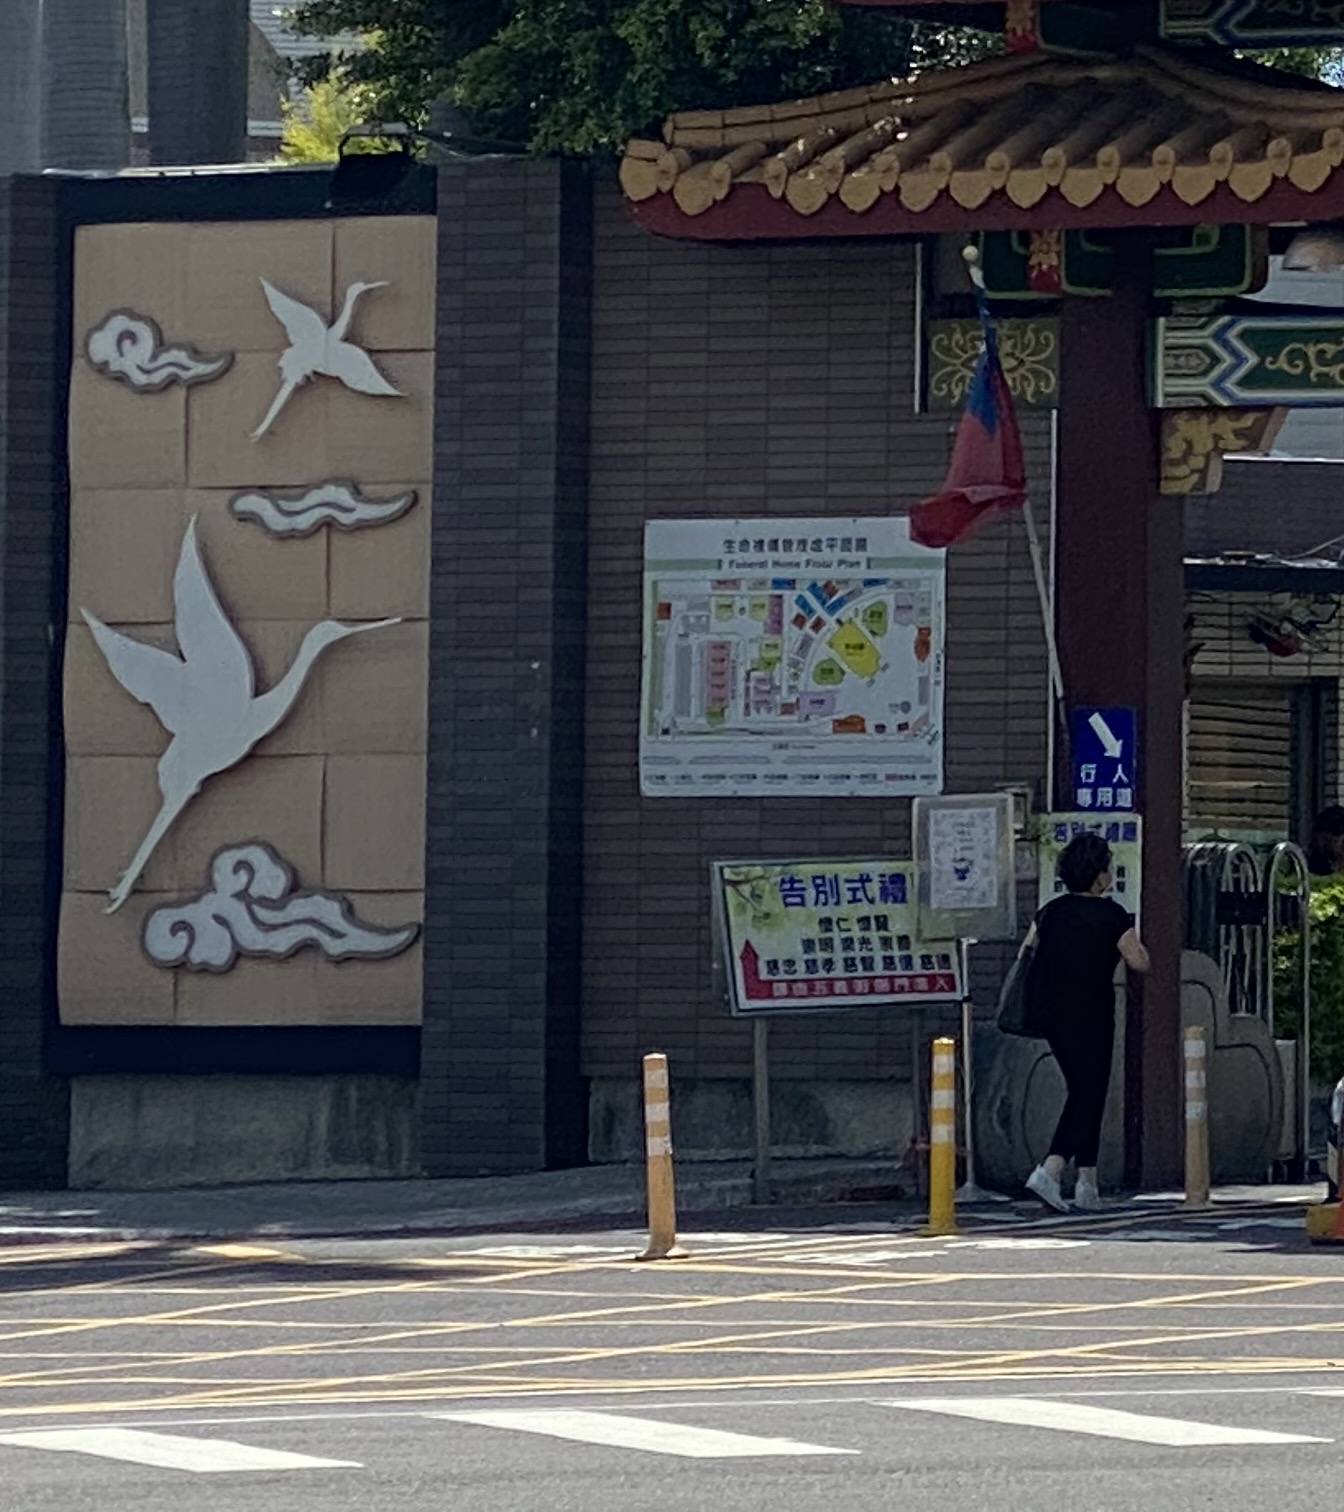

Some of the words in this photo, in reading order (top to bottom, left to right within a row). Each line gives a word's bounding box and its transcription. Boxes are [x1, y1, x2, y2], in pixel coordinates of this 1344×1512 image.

[1080, 763, 1129, 784] 行人
[1076, 787, 1133, 808] 專用道
